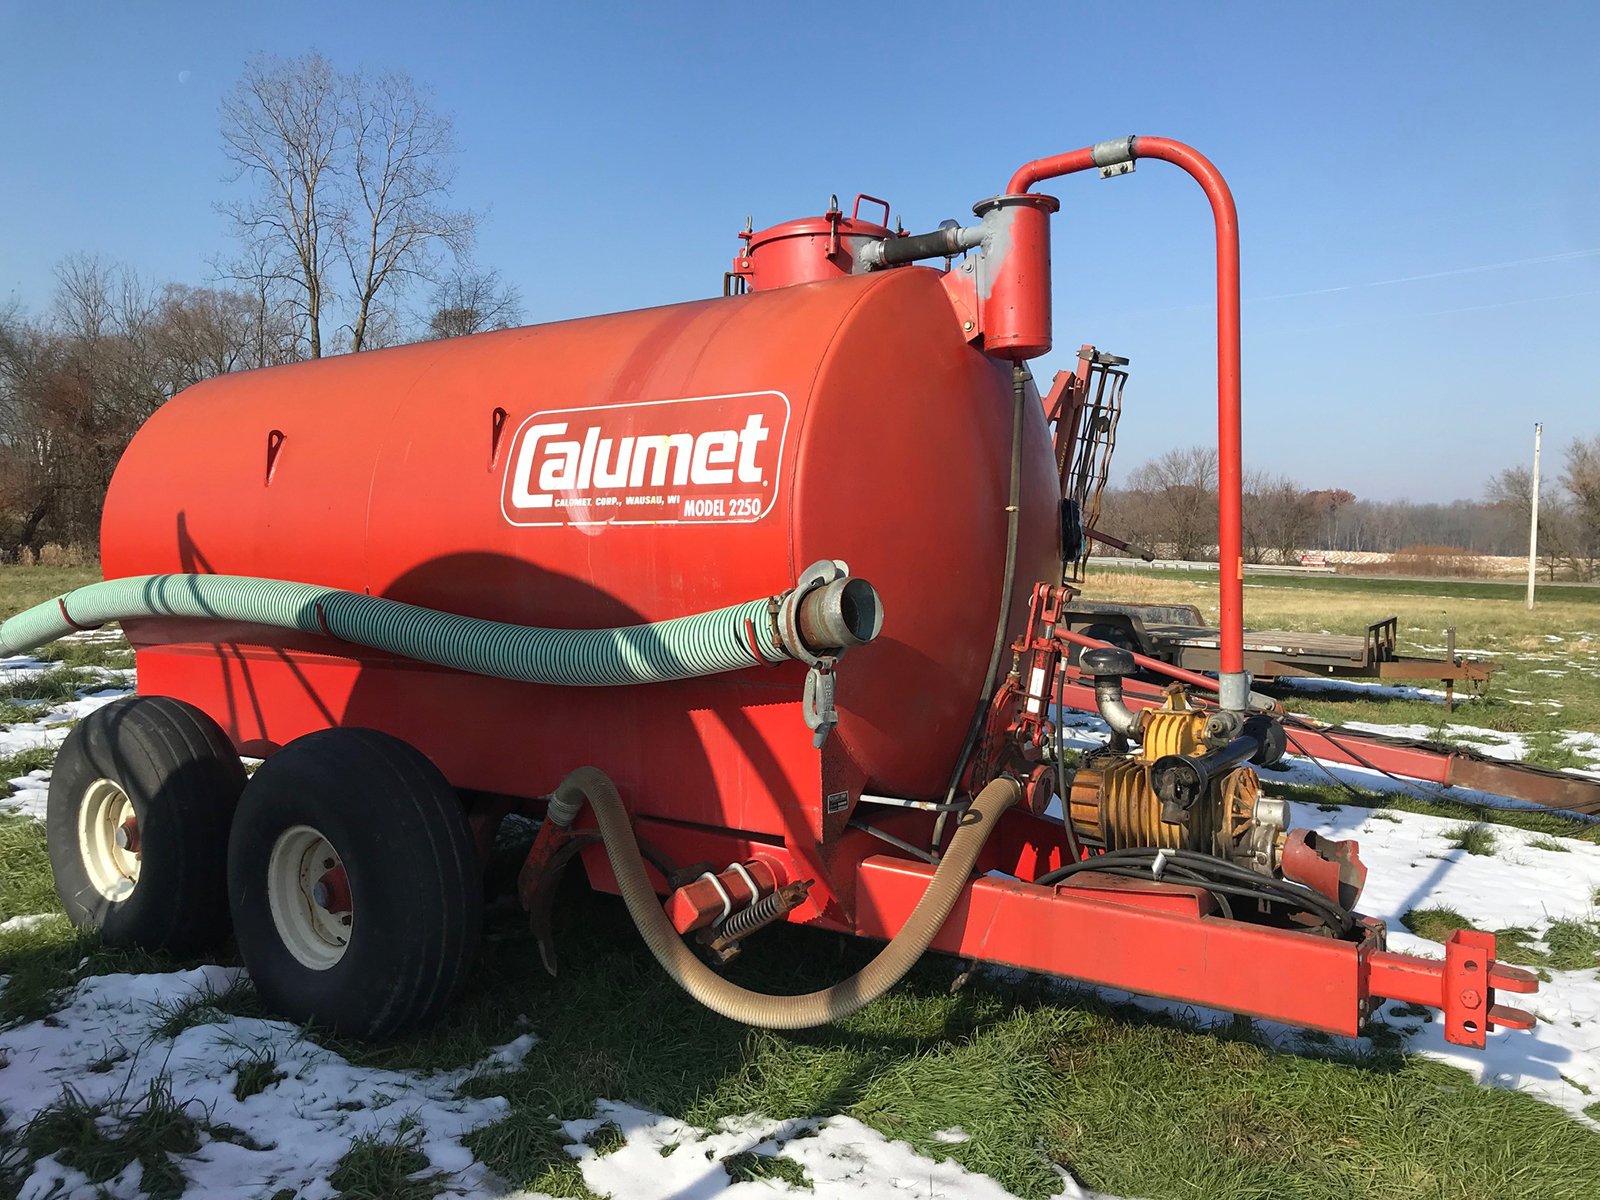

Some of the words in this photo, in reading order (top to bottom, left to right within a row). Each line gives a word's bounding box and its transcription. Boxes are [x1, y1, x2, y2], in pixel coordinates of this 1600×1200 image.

[667, 495, 681, 504] WI
[683, 499, 726, 517] MODEL
[728, 498, 761, 517] 2250
